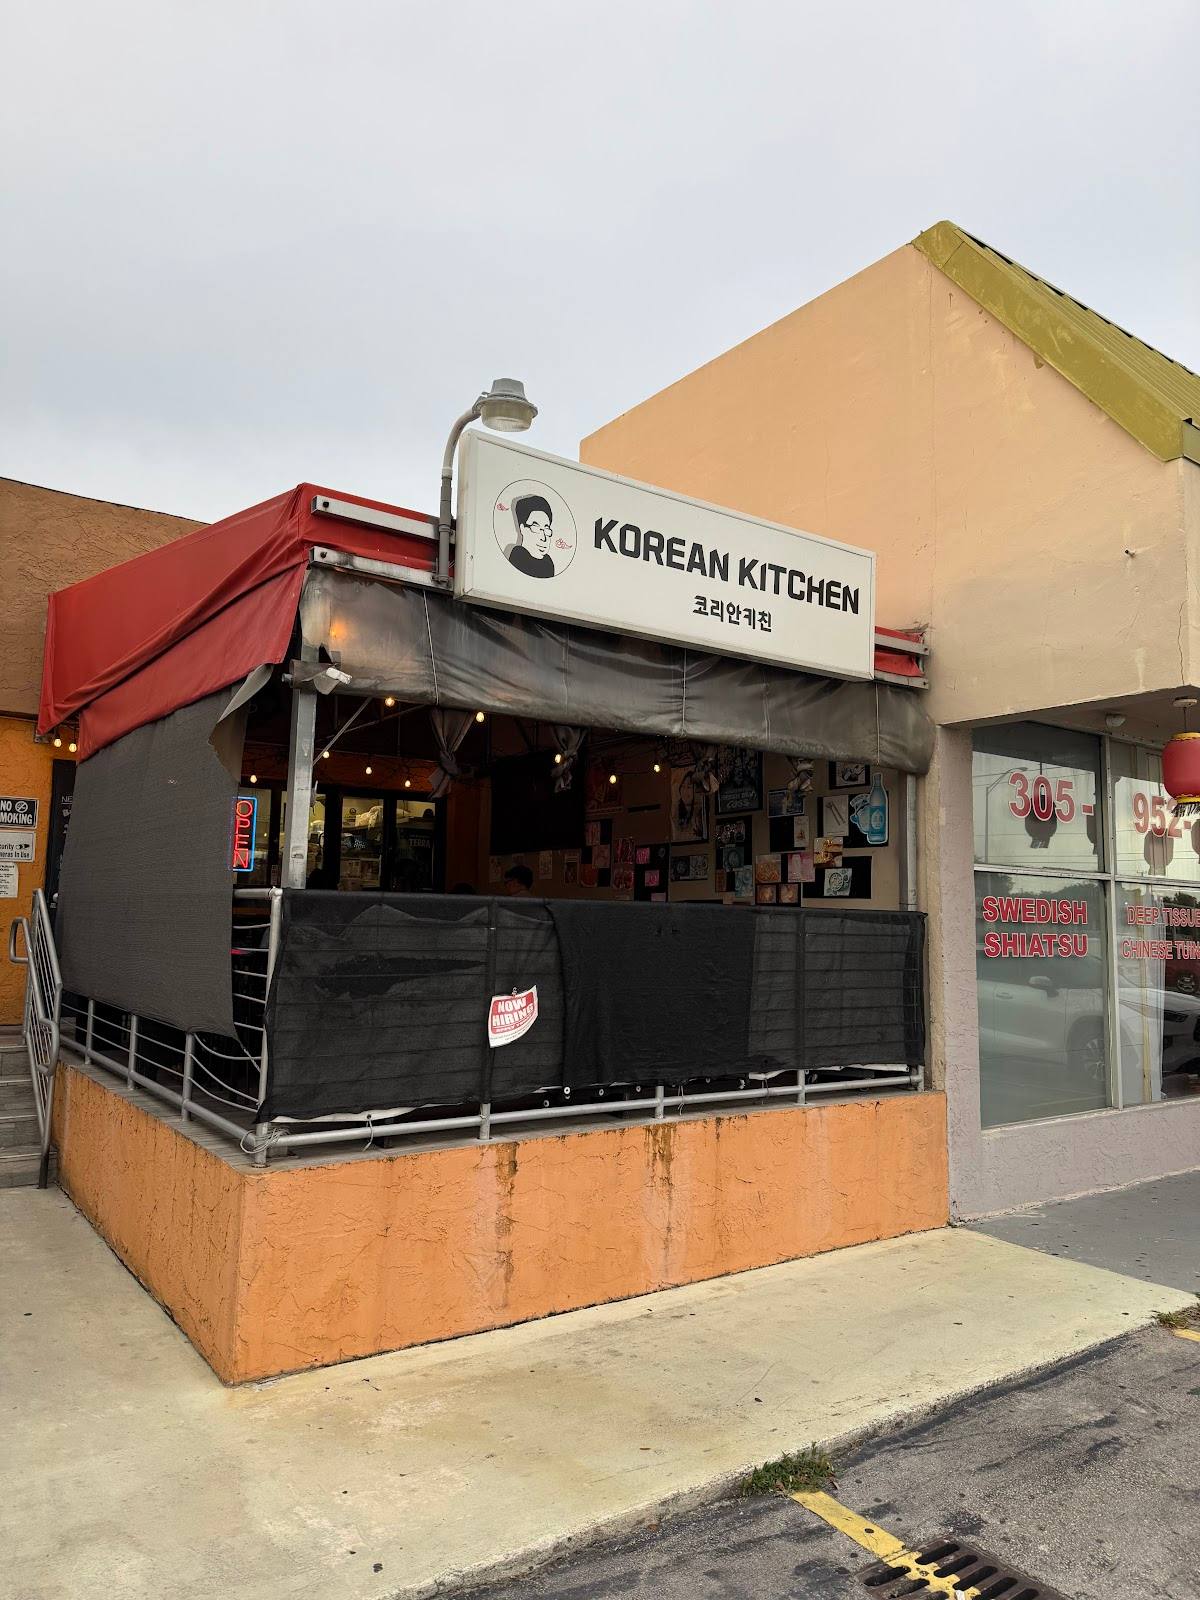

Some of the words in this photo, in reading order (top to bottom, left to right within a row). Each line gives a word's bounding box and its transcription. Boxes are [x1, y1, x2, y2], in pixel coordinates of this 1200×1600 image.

[594, 517, 729, 583] KOREAN
[738, 557, 859, 615] KITCHEN
[692, 594, 773, 633] 코리안키친
[0, 799, 12, 812] NO
[0, 812, 33, 825] MOKING
[234, 800, 253, 868] OPEN
[982, 896, 1088, 925] SWEDISH
[1127, 906, 1159, 925] DEEP
[1162, 907, 1200, 927] TISSUE
[984, 933, 1089, 958] SHIATSU
[1121, 940, 1173, 960] CHINESE
[493, 1003, 534, 1027] HIRING
[498, 996, 527, 1013] NOW
